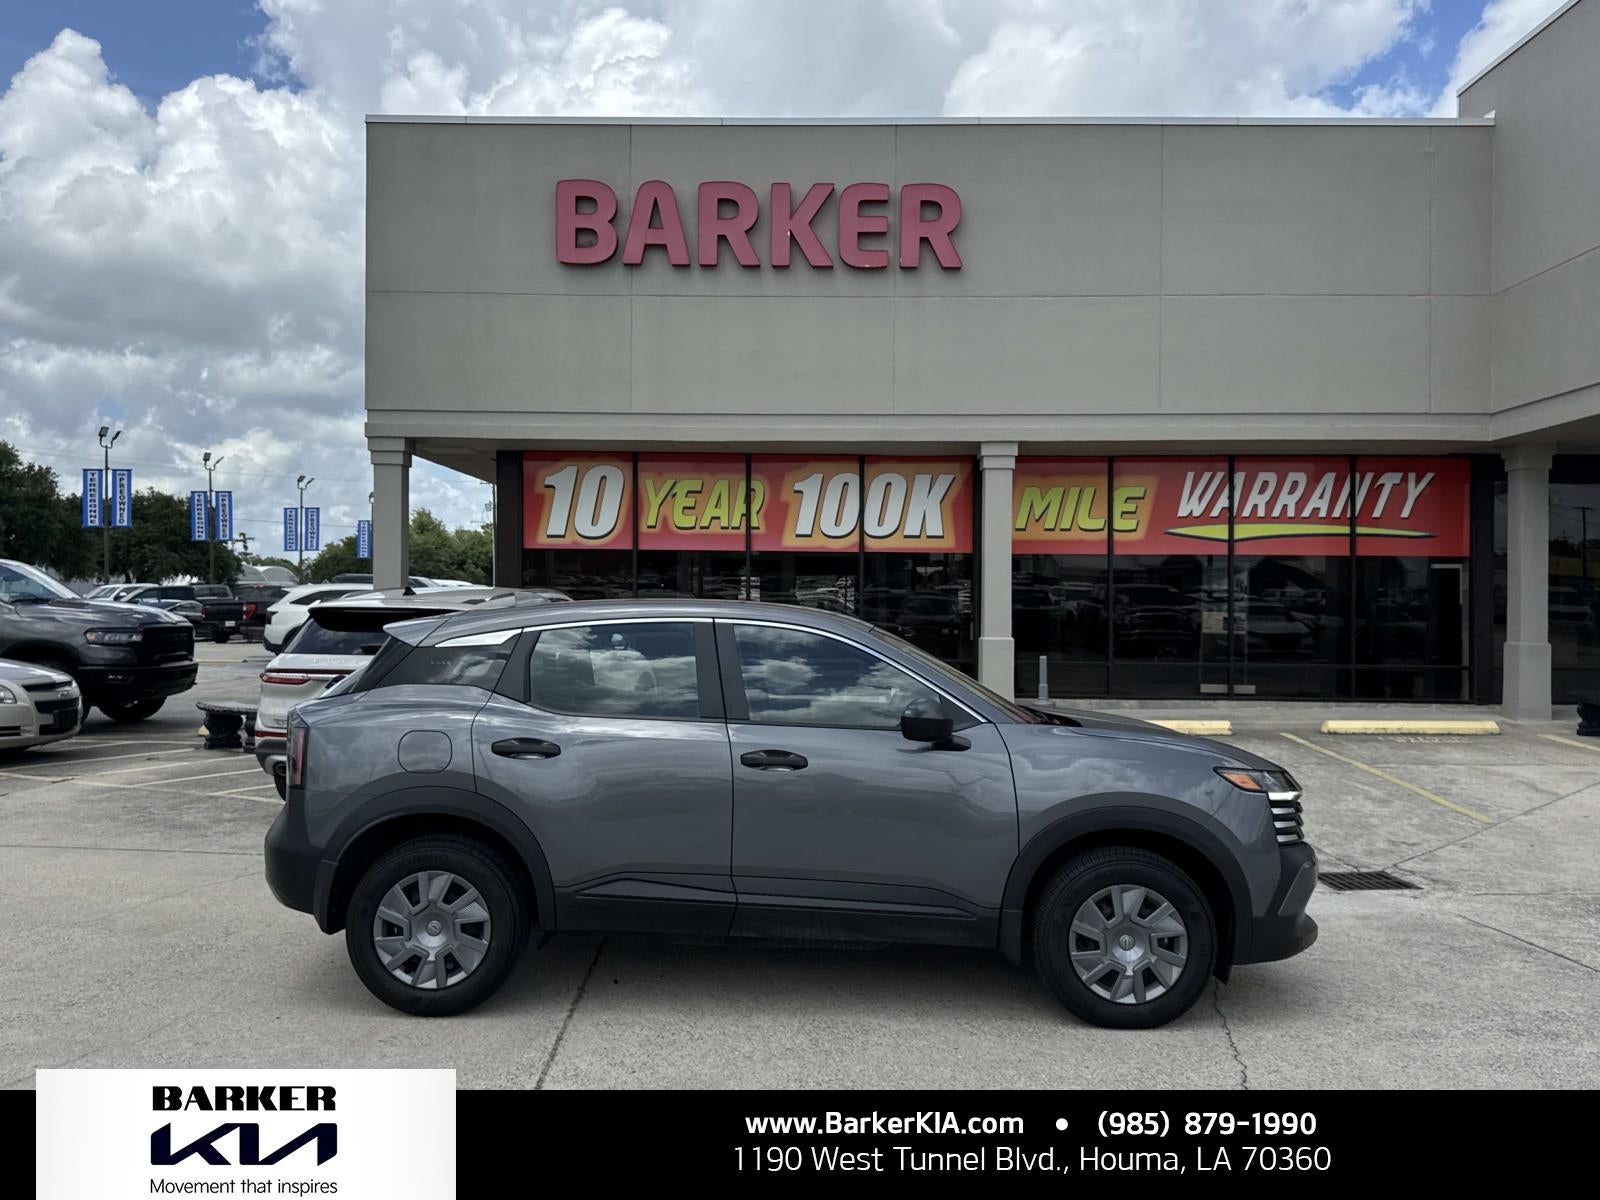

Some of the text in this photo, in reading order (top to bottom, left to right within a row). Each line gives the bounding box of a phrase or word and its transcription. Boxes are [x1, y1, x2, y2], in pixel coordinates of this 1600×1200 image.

[556, 179, 963, 270] BARKER
[118, 477, 127, 524] PREOWNED
[544, 464, 1436, 540] 10 YEAR 100K MILE WARRANTY
